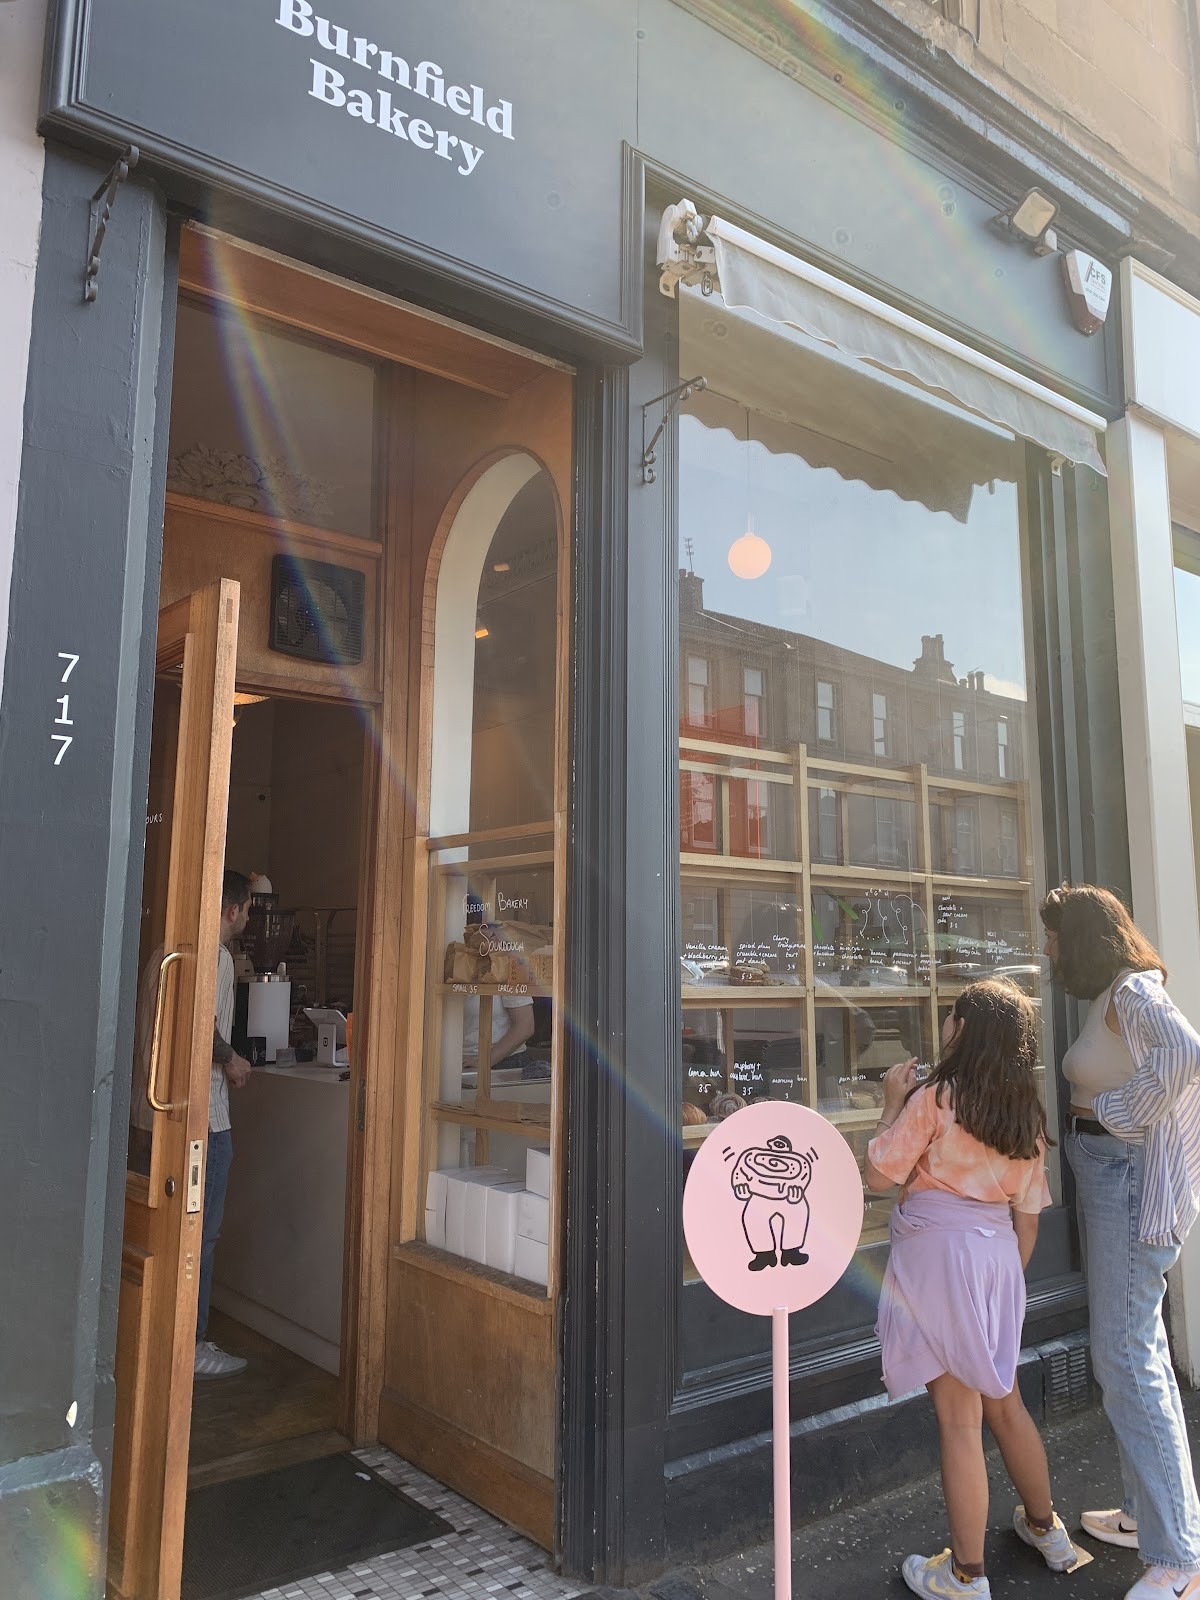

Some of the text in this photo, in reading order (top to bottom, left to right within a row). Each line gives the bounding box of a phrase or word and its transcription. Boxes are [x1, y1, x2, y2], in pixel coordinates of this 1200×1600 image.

[275, 0, 514, 140] Burnfield
[308, 58, 484, 176] Bakery
[1090, 267, 1106, 284] CFS
[686, 941, 706, 950] Vanilla
